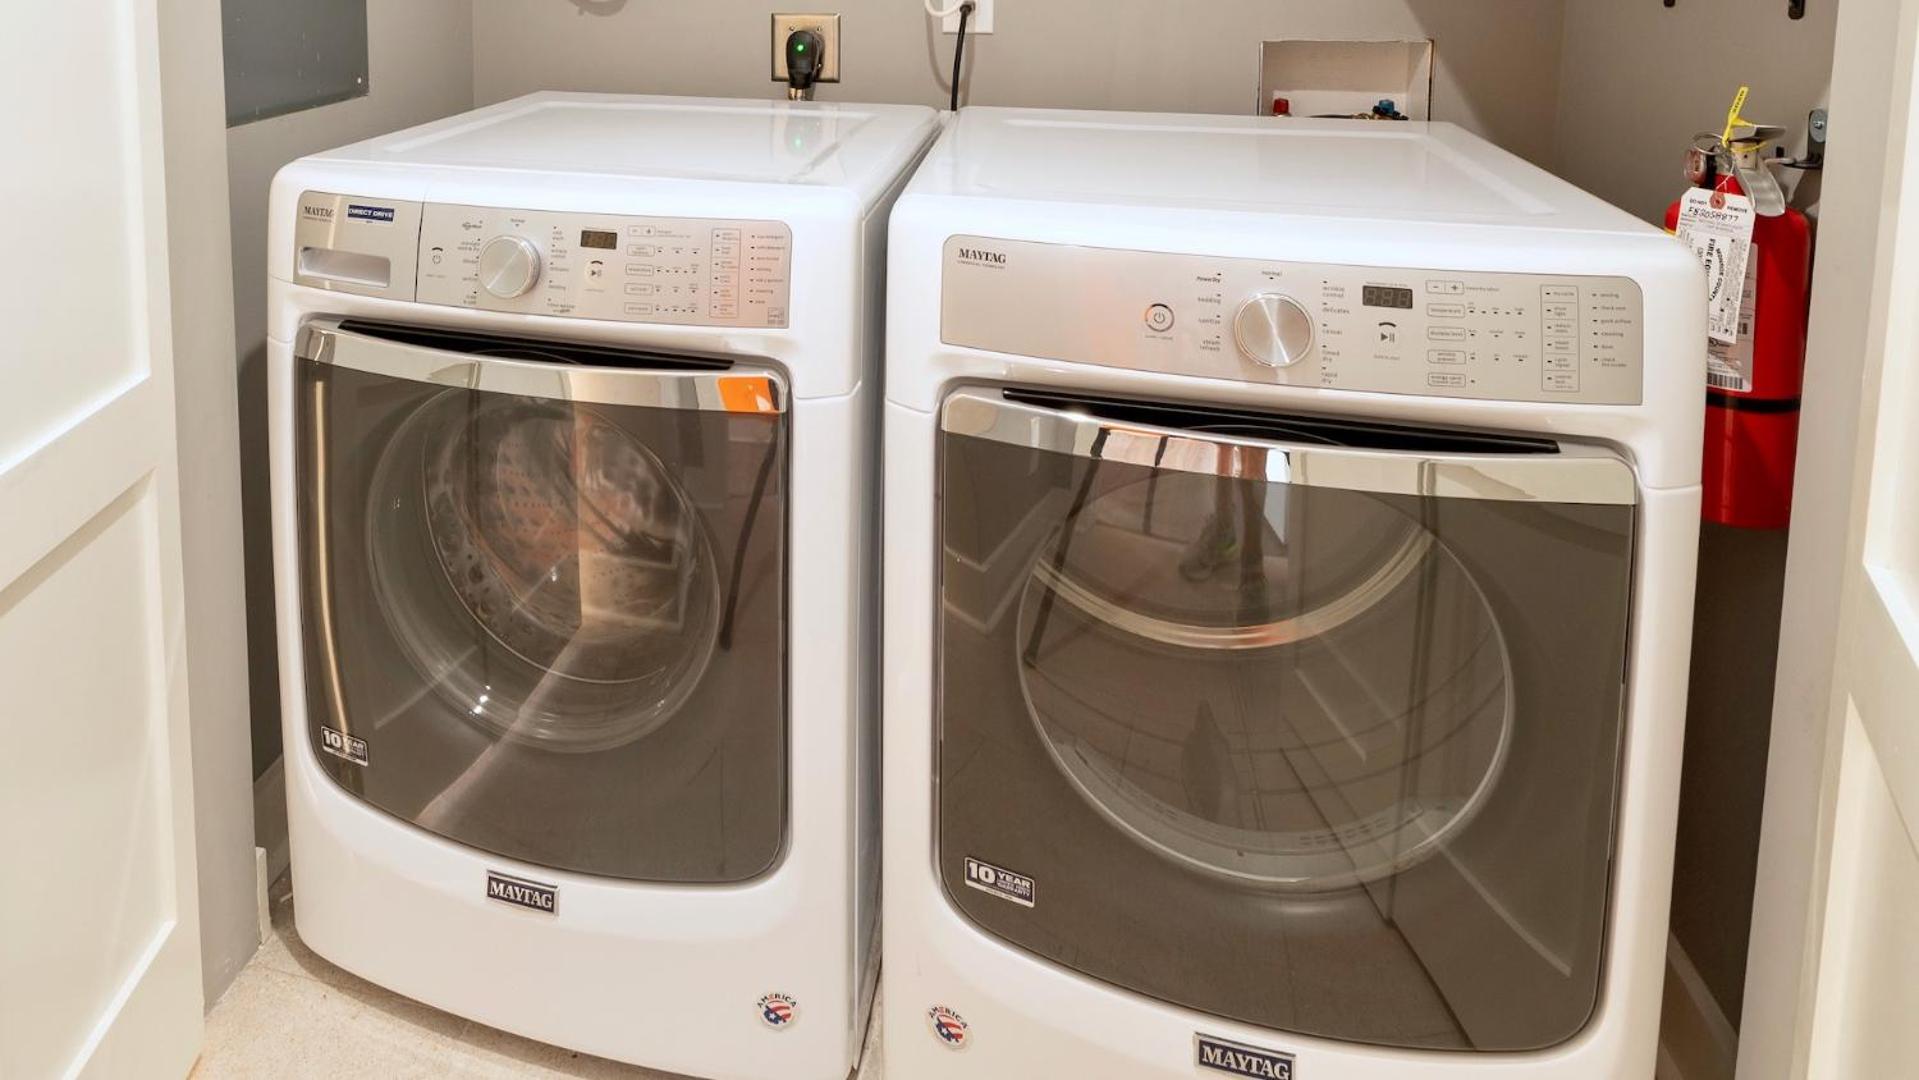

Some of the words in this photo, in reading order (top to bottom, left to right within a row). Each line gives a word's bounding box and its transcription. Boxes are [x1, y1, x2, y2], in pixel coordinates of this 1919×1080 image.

[348, 208, 372, 216] DIRECT
[958, 248, 1006, 264] MAYTAG
[323, 730, 342, 748] 10
[968, 862, 996, 884] 10
[997, 872, 1030, 889] YEAR
[489, 881, 553, 908] MAYTAG
[757, 993, 797, 1009] AMERICA
[1202, 1045, 1290, 1080] MAYTAG
